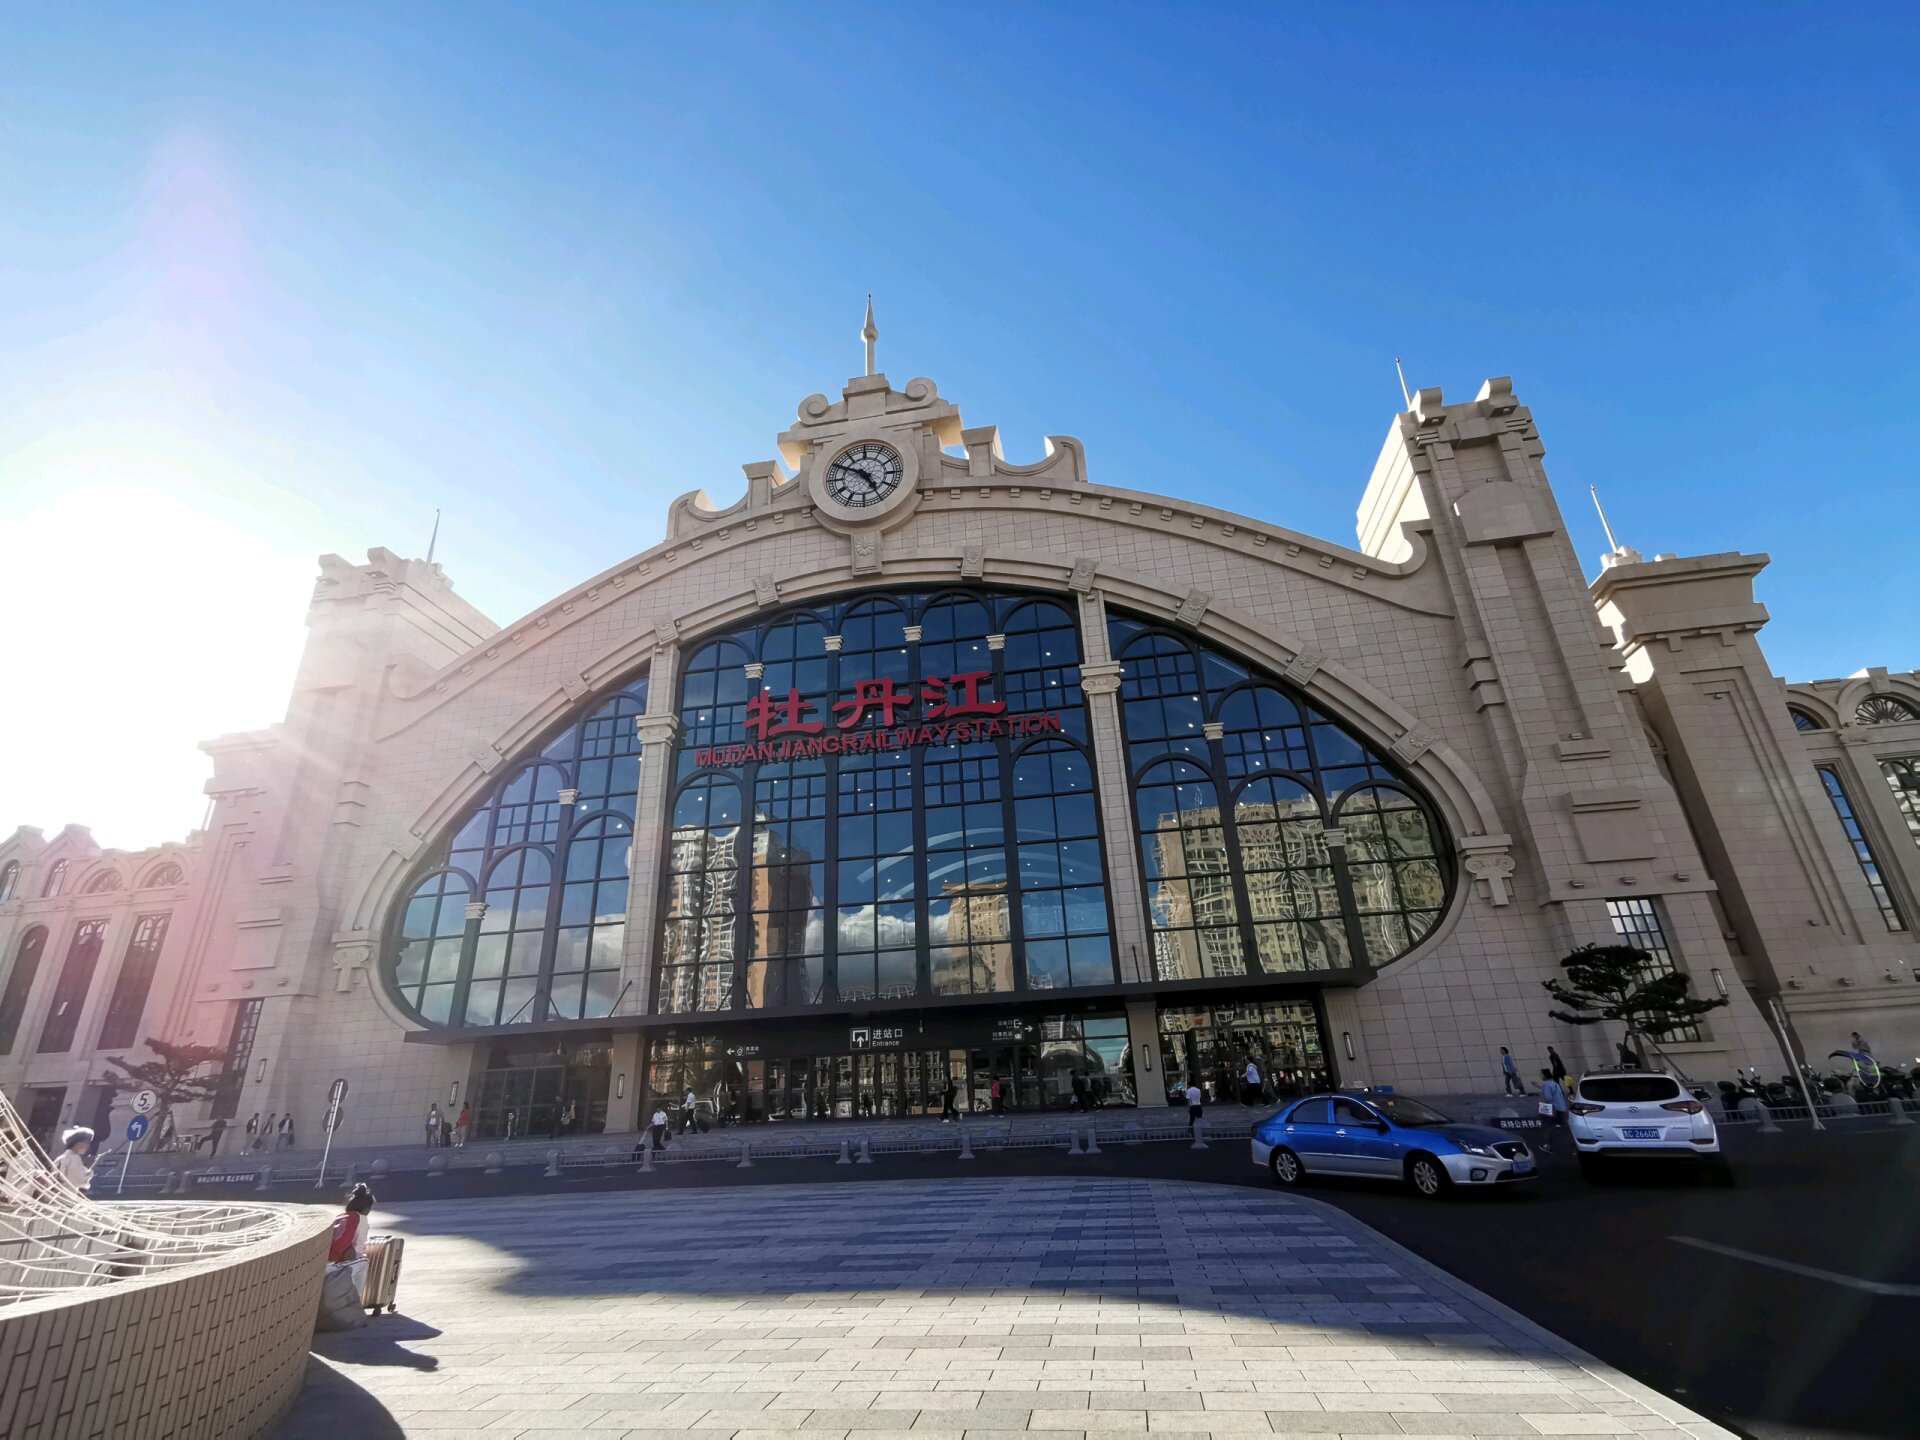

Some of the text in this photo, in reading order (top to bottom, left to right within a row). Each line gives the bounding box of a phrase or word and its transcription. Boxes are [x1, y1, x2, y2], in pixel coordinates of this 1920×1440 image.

[743, 671, 1007, 740] 牡丹江
[955, 712, 1062, 739] STATION
[872, 1028, 903, 1040] 进站口
[138, 1093, 150, 1107] 5
[1500, 1119, 1543, 1129] 保持公共秩序
